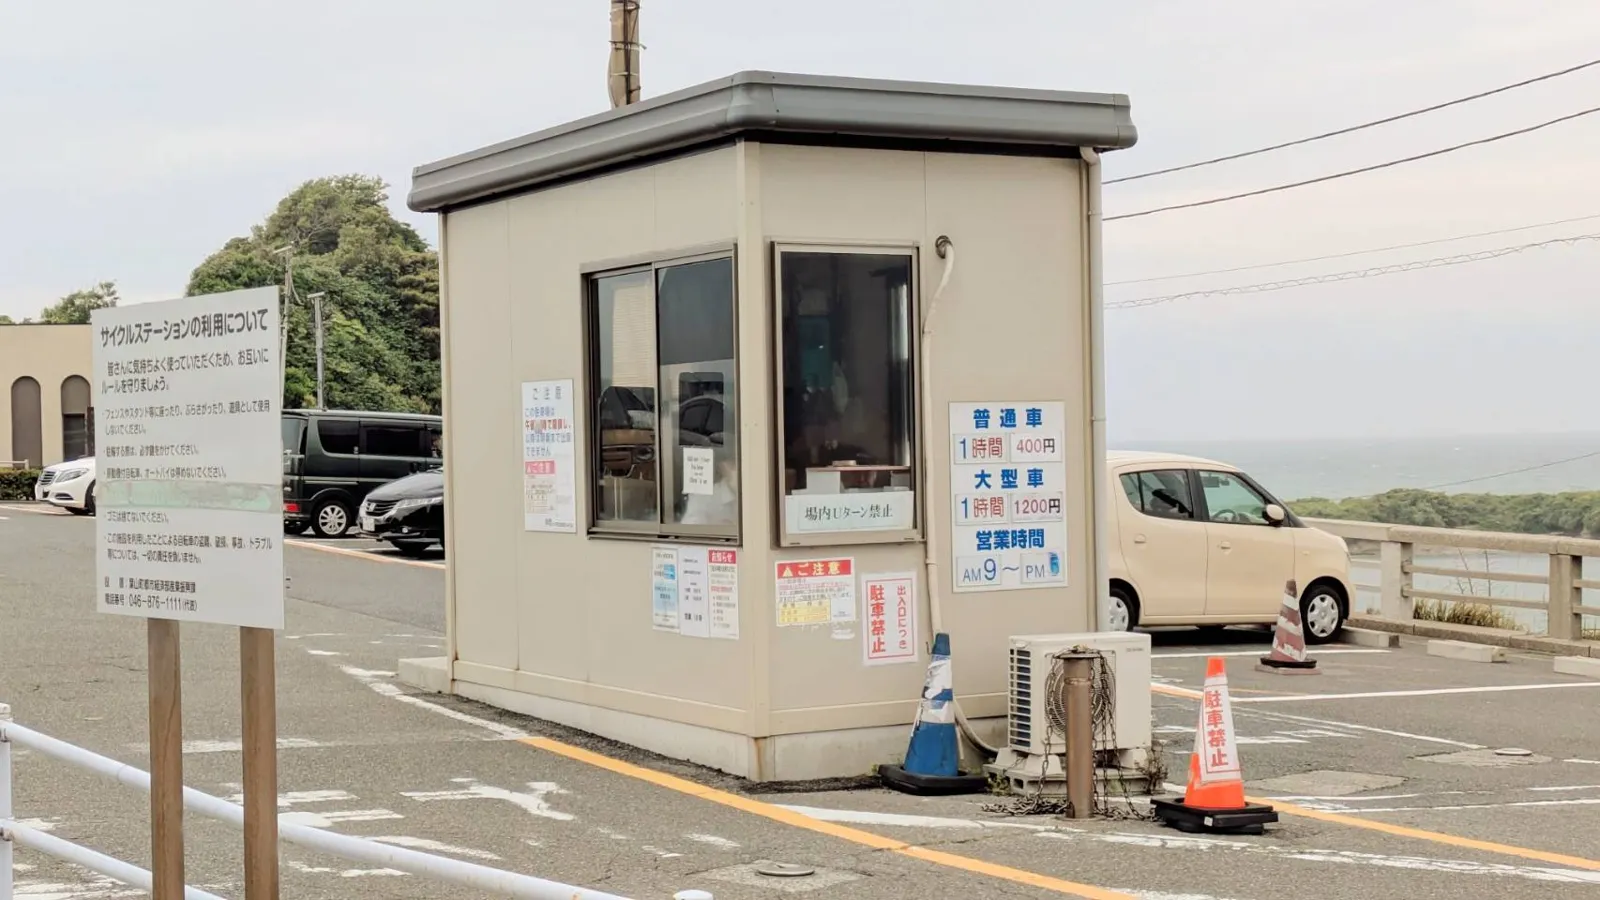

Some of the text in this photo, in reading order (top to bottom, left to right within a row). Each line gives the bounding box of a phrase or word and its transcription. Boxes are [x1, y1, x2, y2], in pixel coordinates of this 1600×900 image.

[101, 309, 268, 347] サイクルステーションの利用について
[102, 377, 169, 394] ルールを守りましょう。
[973, 408, 1043, 429] 普通車
[959, 437, 1055, 459] 1時間 400円
[974, 468, 1044, 489] 大型車
[805, 504, 893, 521] 場内Uターン禁止
[961, 496, 1061, 519] 1時間 1200円
[976, 529, 1045, 551] 営業時間
[798, 561, 841, 576] ご注意
[870, 584, 886, 654] 駐車禁止
[897, 585, 908, 650] 出入口につき
[1204, 690, 1229, 767] 駐車禁止
